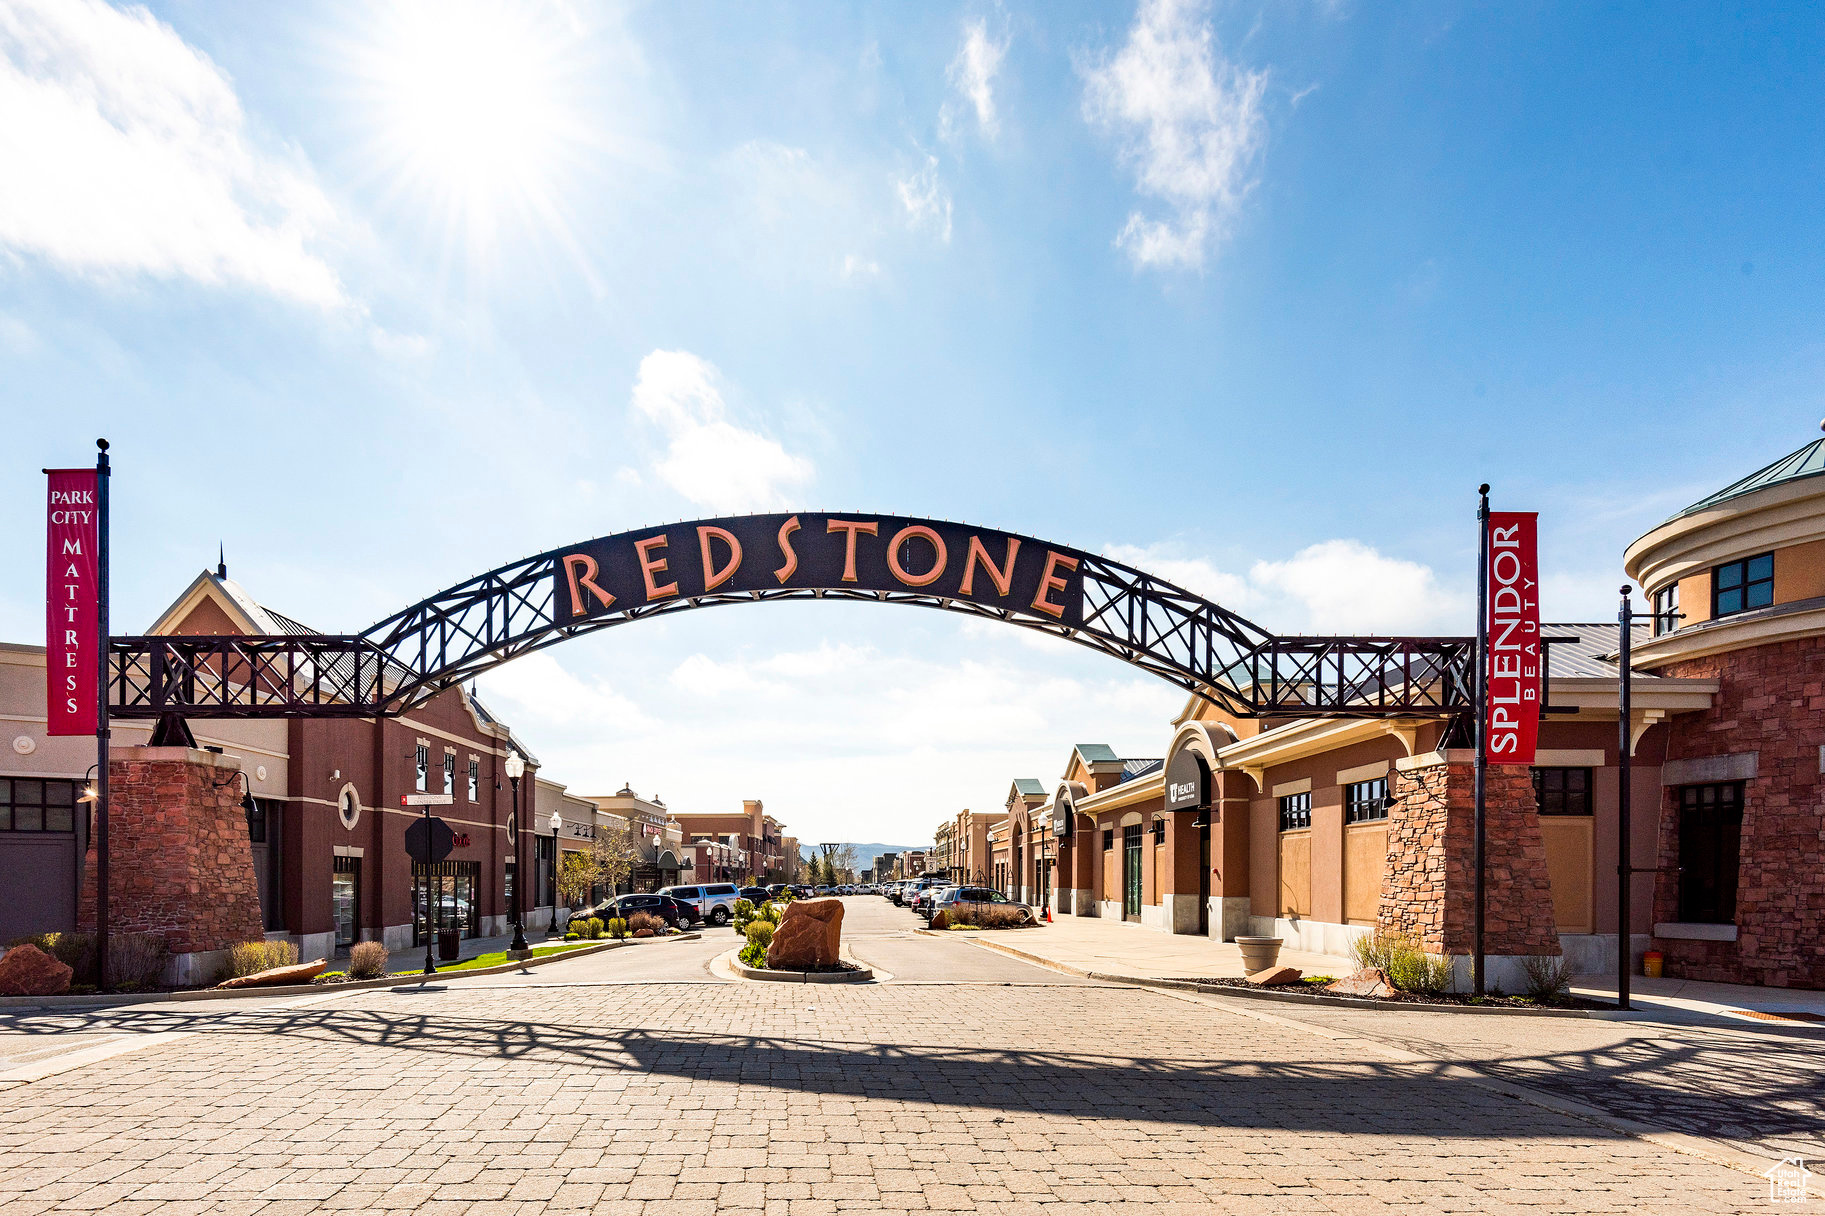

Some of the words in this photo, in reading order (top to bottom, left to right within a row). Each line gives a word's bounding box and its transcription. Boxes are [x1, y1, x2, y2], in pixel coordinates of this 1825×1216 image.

[51, 490, 93, 505] PARK
[51, 510, 92, 525] CITY
[561, 515, 1079, 619] REDSTONE
[62, 538, 82, 714] MATTRESS
[1490, 522, 1521, 754] SPLENDOR
[1524, 577, 1536, 701] BEAUTY
[1178, 781, 1195, 796] HEALTH
